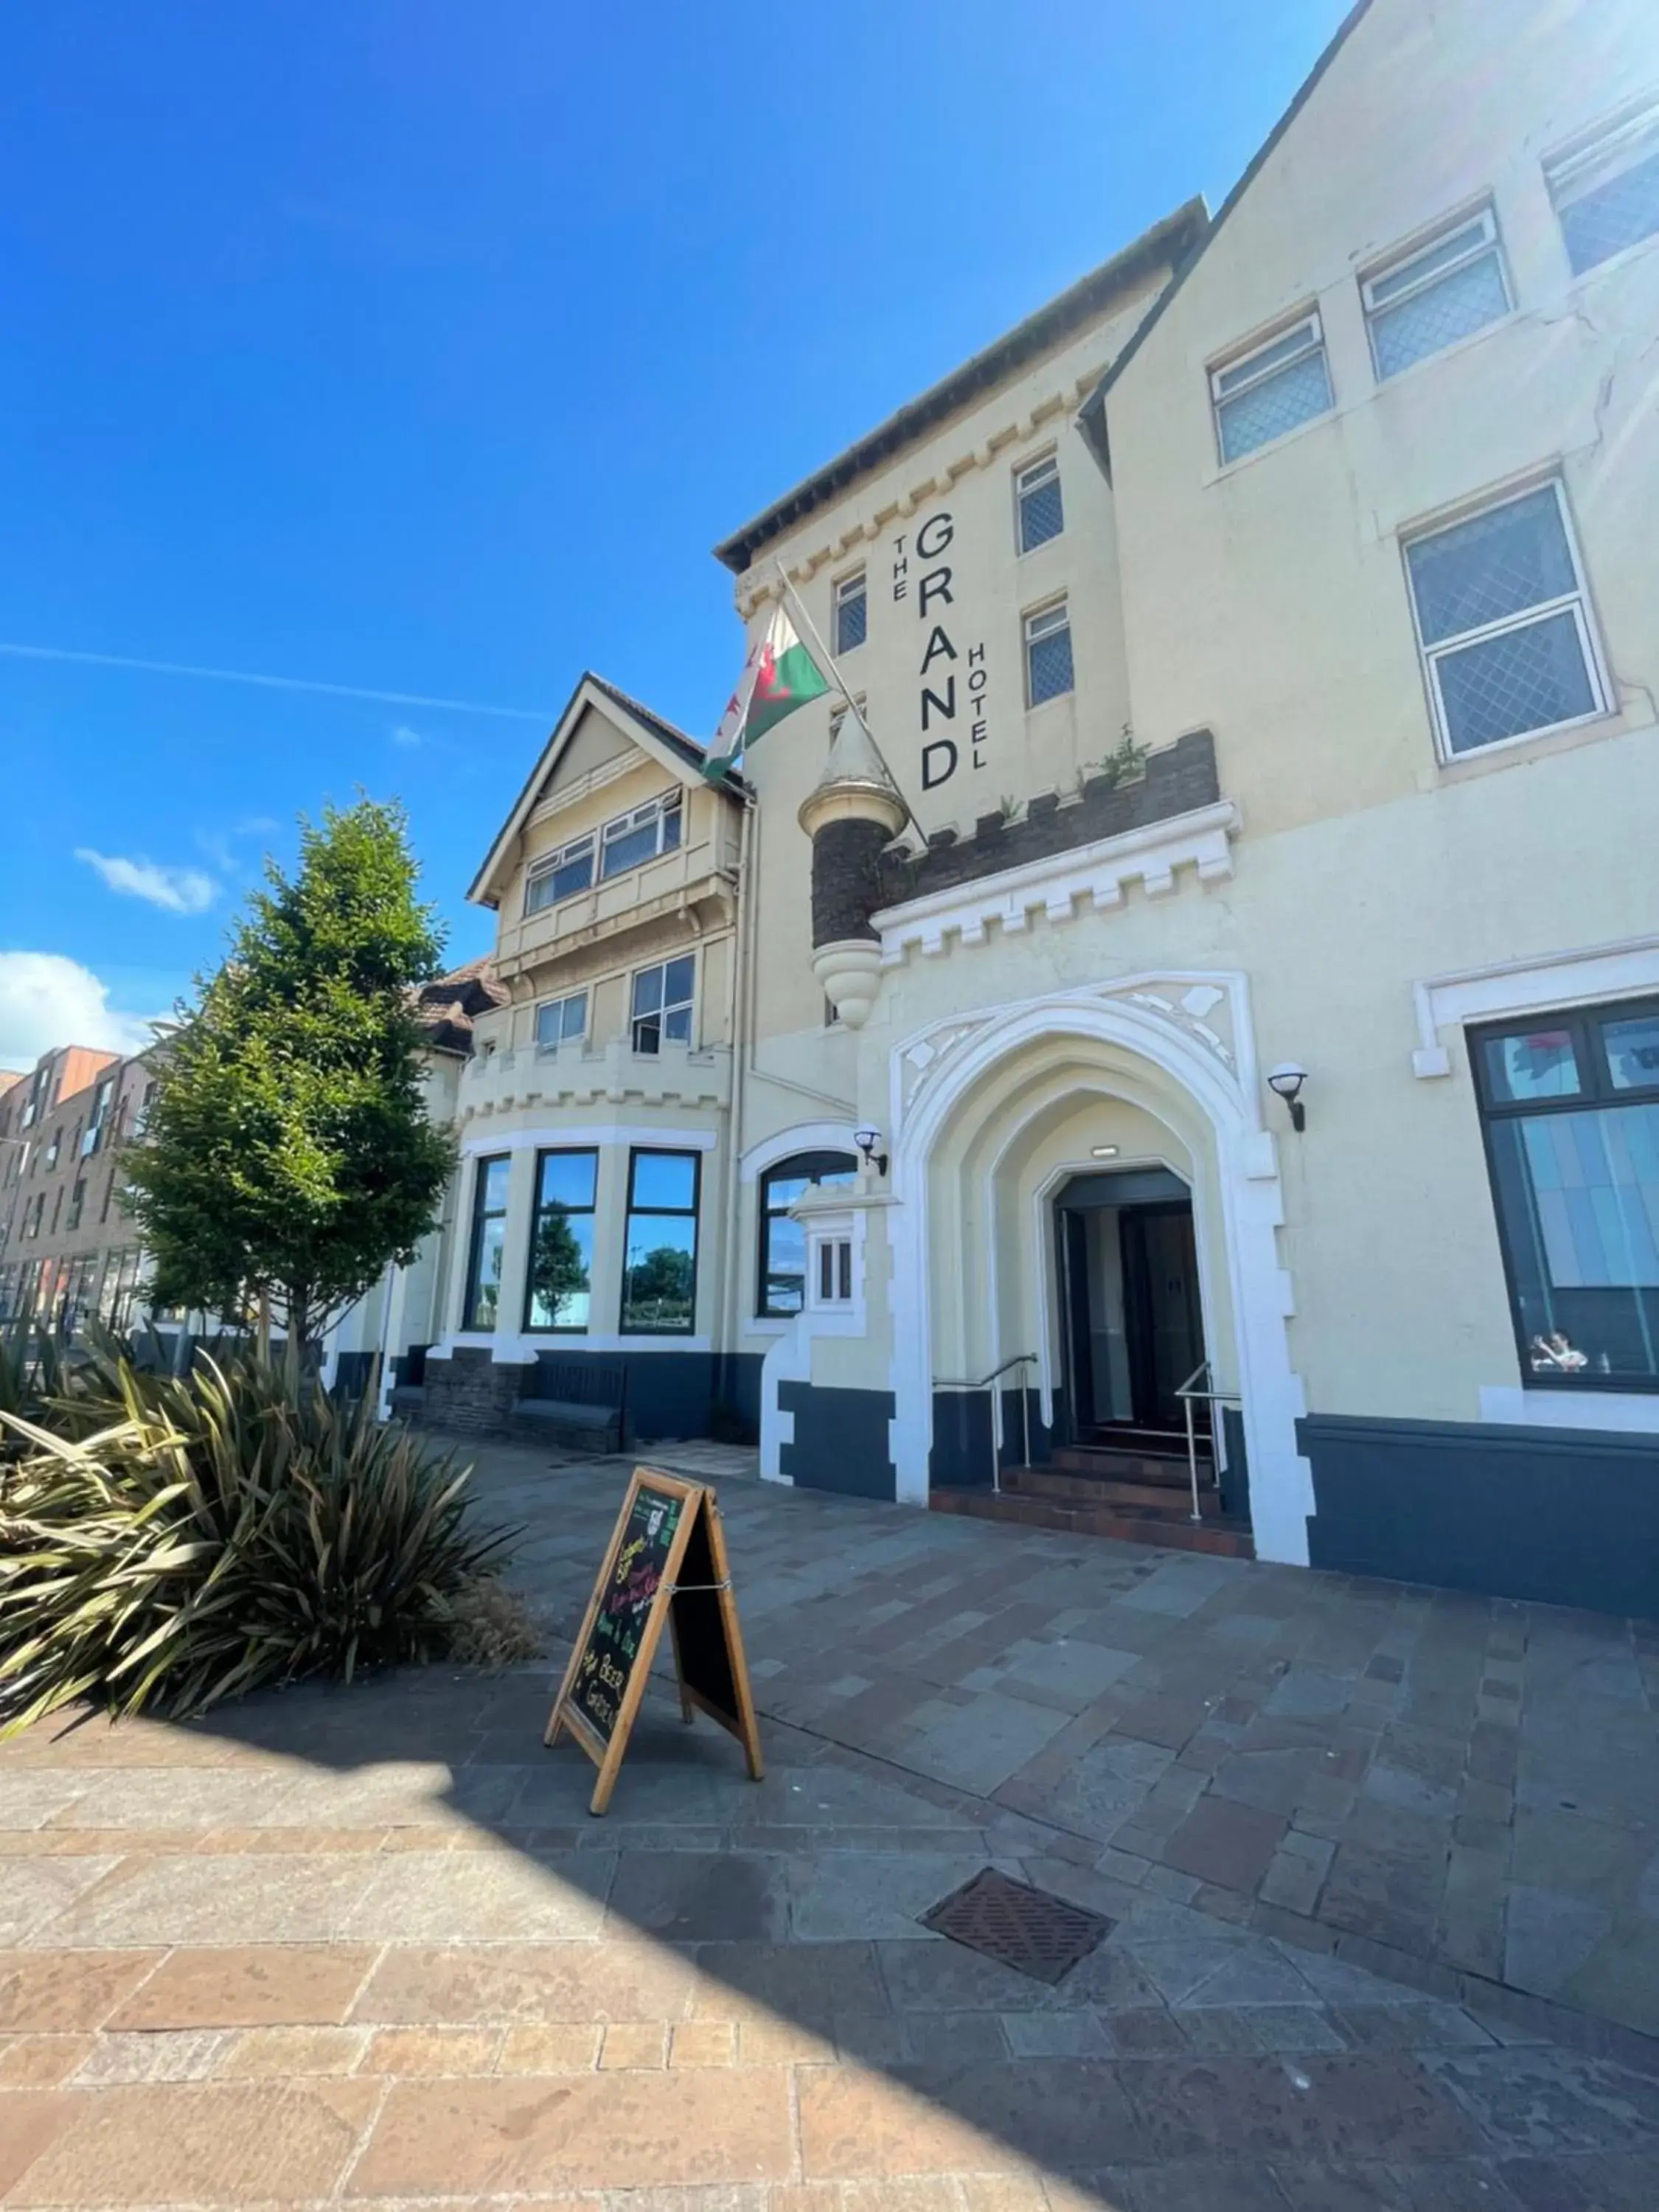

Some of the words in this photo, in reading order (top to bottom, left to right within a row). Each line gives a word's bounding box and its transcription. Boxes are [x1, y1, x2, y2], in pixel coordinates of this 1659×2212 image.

[894, 535, 908, 601] THE
[917, 512, 958, 790] GRAND
[968, 643, 987, 769] HOTEL
